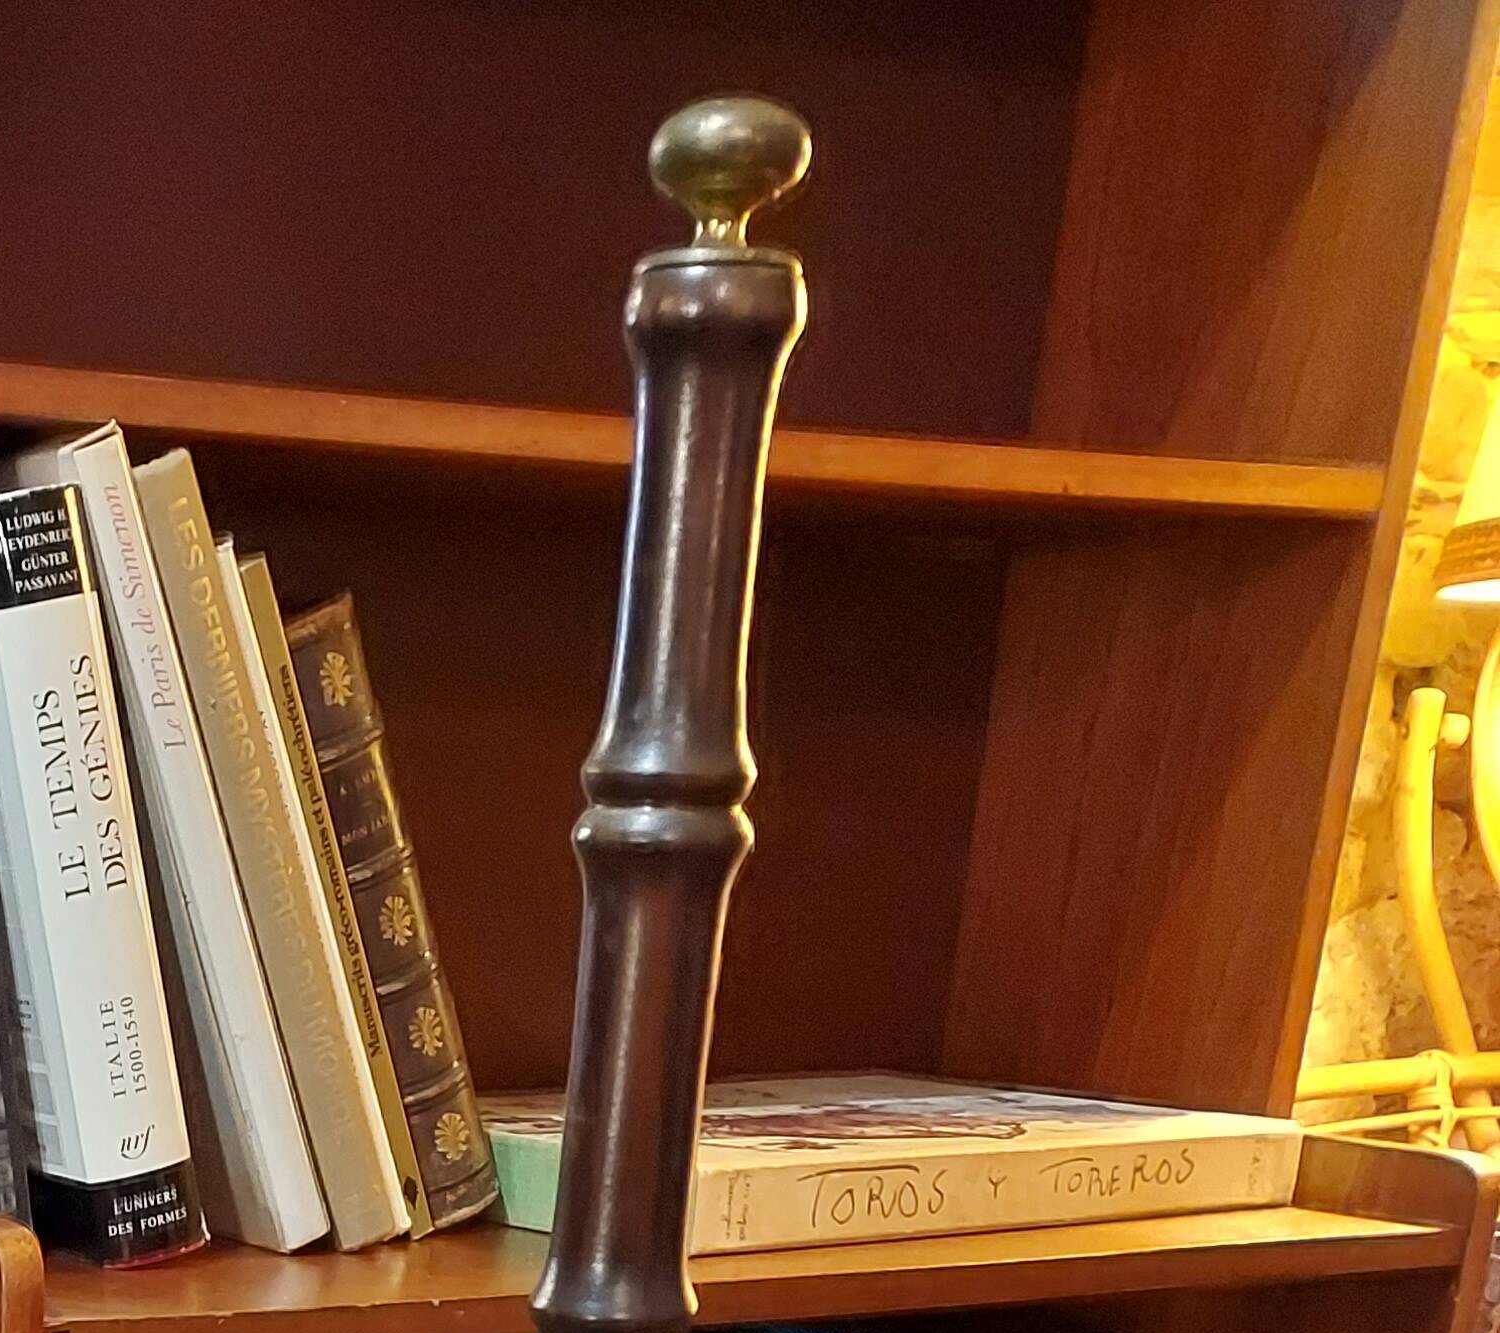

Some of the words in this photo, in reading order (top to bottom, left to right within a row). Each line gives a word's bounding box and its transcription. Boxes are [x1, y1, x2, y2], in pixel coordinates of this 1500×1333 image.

[6, 510, 55, 531] LUDWIG
[103, 484, 148, 600] Simenon
[15, 569, 78, 594] PASSAVANT
[21, 551, 69, 572] GÜNTER
[132, 608, 155, 634] de
[166, 495, 204, 571] LES
[189, 577, 257, 762] DERNIERS
[140, 644, 176, 709] Paris
[32, 690, 79, 829] TEMPS
[69, 654, 113, 802] GÉNIES
[163, 719, 187, 749] Le
[58, 845, 91, 900] LE
[96, 818, 127, 891] DES
[99, 1000, 126, 1098] ITALIE
[120, 996, 147, 1094] 1500-1540
[108, 1222, 133, 1237] DES
[141, 1206, 187, 1230] FORMES
[797, 1164, 946, 1229] TOROS
[1038, 1147, 1195, 1197] TOREROS
